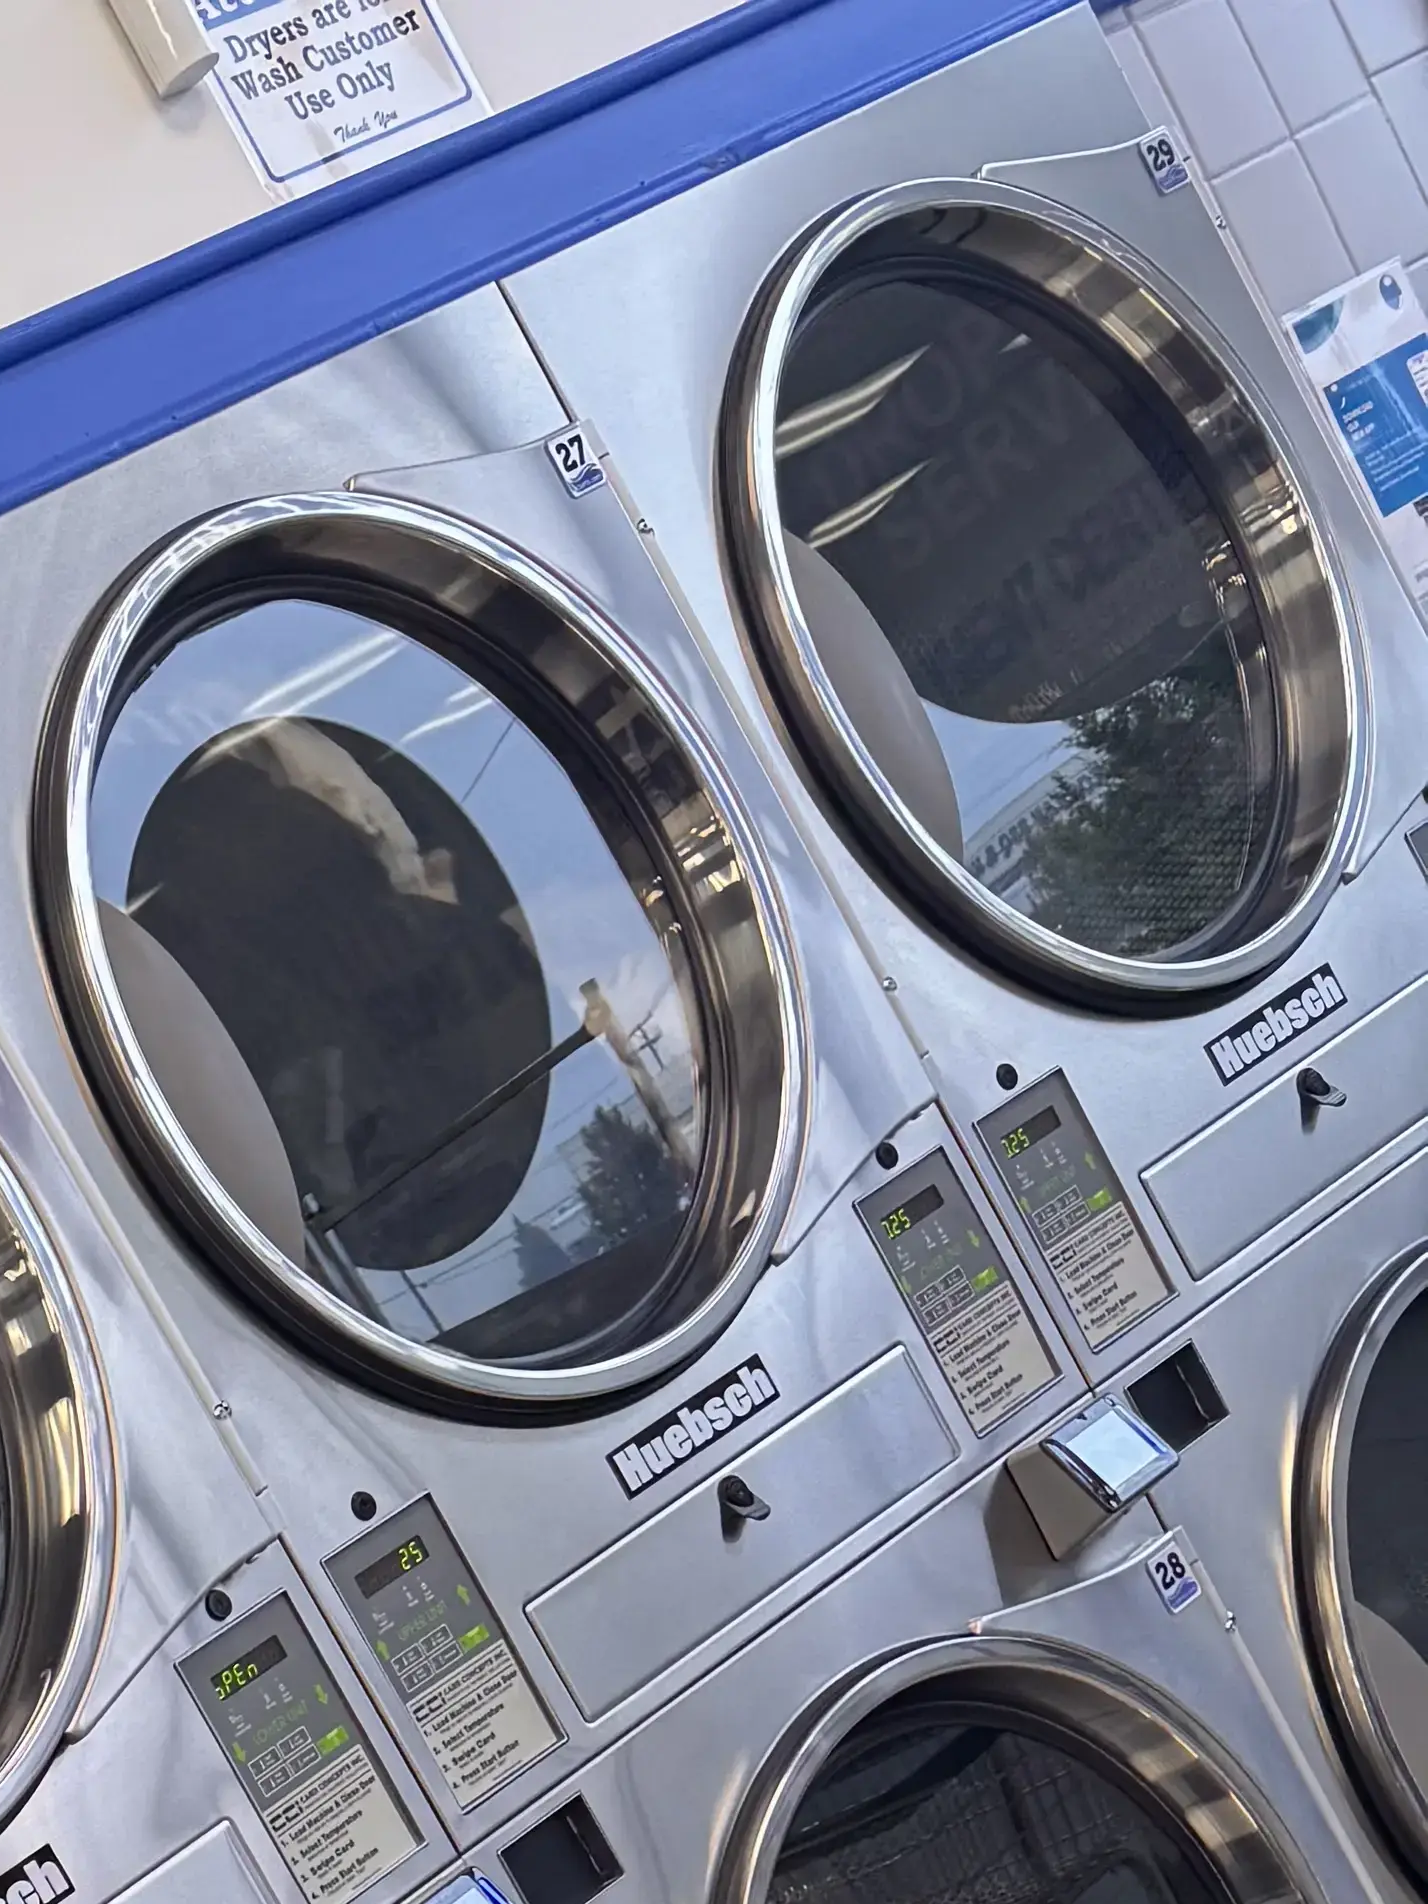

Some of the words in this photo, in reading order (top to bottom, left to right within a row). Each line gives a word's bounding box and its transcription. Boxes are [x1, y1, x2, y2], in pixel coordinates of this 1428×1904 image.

[223, 16, 309, 63] Dryers
[311, 1, 351, 30] are
[231, 57, 303, 101] Wash
[302, 9, 421, 72] Customer
[284, 88, 336, 120] Use
[336, 60, 396, 99] Only
[1147, 139, 1175, 171] 29
[556, 433, 585, 472] 27
[1208, 972, 1345, 1079] Huebsch
[611, 1366, 776, 1492] Huebsch
[1154, 1552, 1186, 1590] 28
